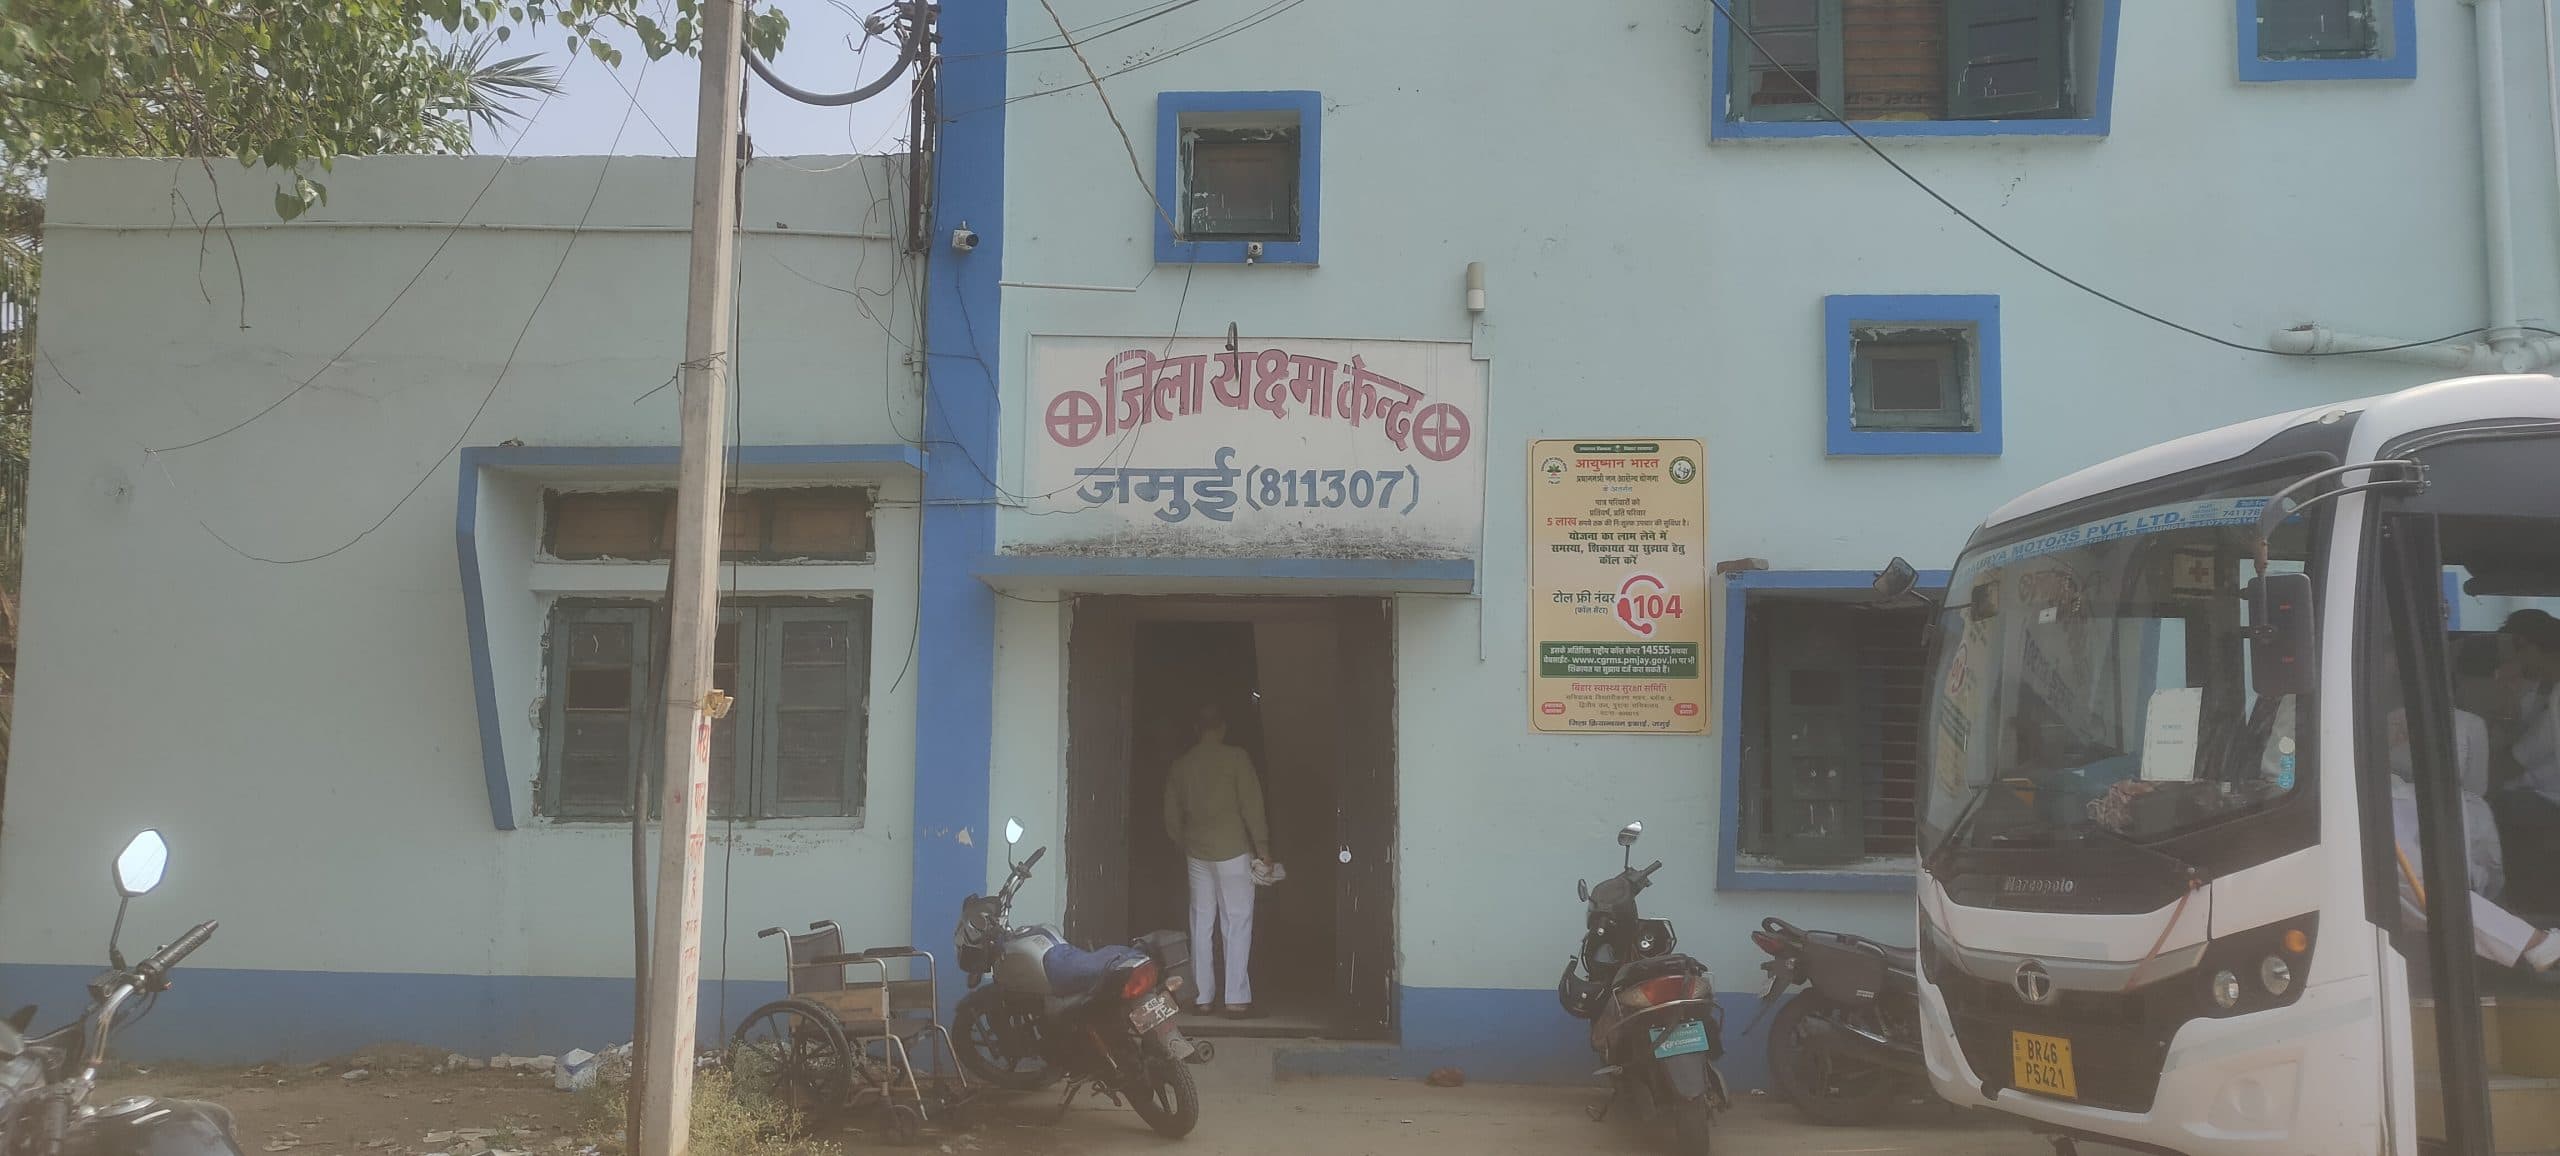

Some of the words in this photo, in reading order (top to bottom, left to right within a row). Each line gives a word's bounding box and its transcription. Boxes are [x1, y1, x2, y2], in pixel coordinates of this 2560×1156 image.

[1100, 349, 1207, 437] जिला
[1575, 457, 1626, 472] आयुष्मान
[1631, 457, 1660, 469] भारत
[1074, 446, 1241, 523] जमुई
[1244, 463, 1420, 516] (811307)
[1631, 498, 1640, 506] को
[1626, 508, 1646, 517] परिवार
[1546, 517, 1553, 526] 5
[1555, 517, 1577, 527] लाख
[2086, 520, 2129, 538] PVT.
[2136, 511, 2186, 528] LTD.
[1568, 530, 1598, 541] योजना
[1601, 531, 1614, 541] का
[1640, 530, 1656, 541] लेने
[1659, 529, 1667, 541] में
[1551, 543, 1584, 554] समस्या,
[1588, 542, 1625, 553] शिकायत
[1628, 543, 1639, 553] या
[1642, 544, 1669, 556] सुझाव
[1672, 542, 1686, 556] हेतु
[1599, 554, 1620, 565] कॉल
[1623, 553, 1638, 565] करें
[1552, 591, 1573, 604] टोल
[1576, 589, 1591, 604] फ्री
[1594, 590, 1616, 604] नंबर
[1633, 594, 1683, 619] 104
[1574, 606, 1592, 616] (कॉल
[1640, 645, 1670, 655] 14555
[1571, 682, 1593, 692] बिहार
[1622, 684, 1642, 695] सुरक्षा
[1643, 682, 1668, 693] समिति
[2027, 1039, 2058, 1065] BR46
[2025, 1062, 2066, 1089] P5421
